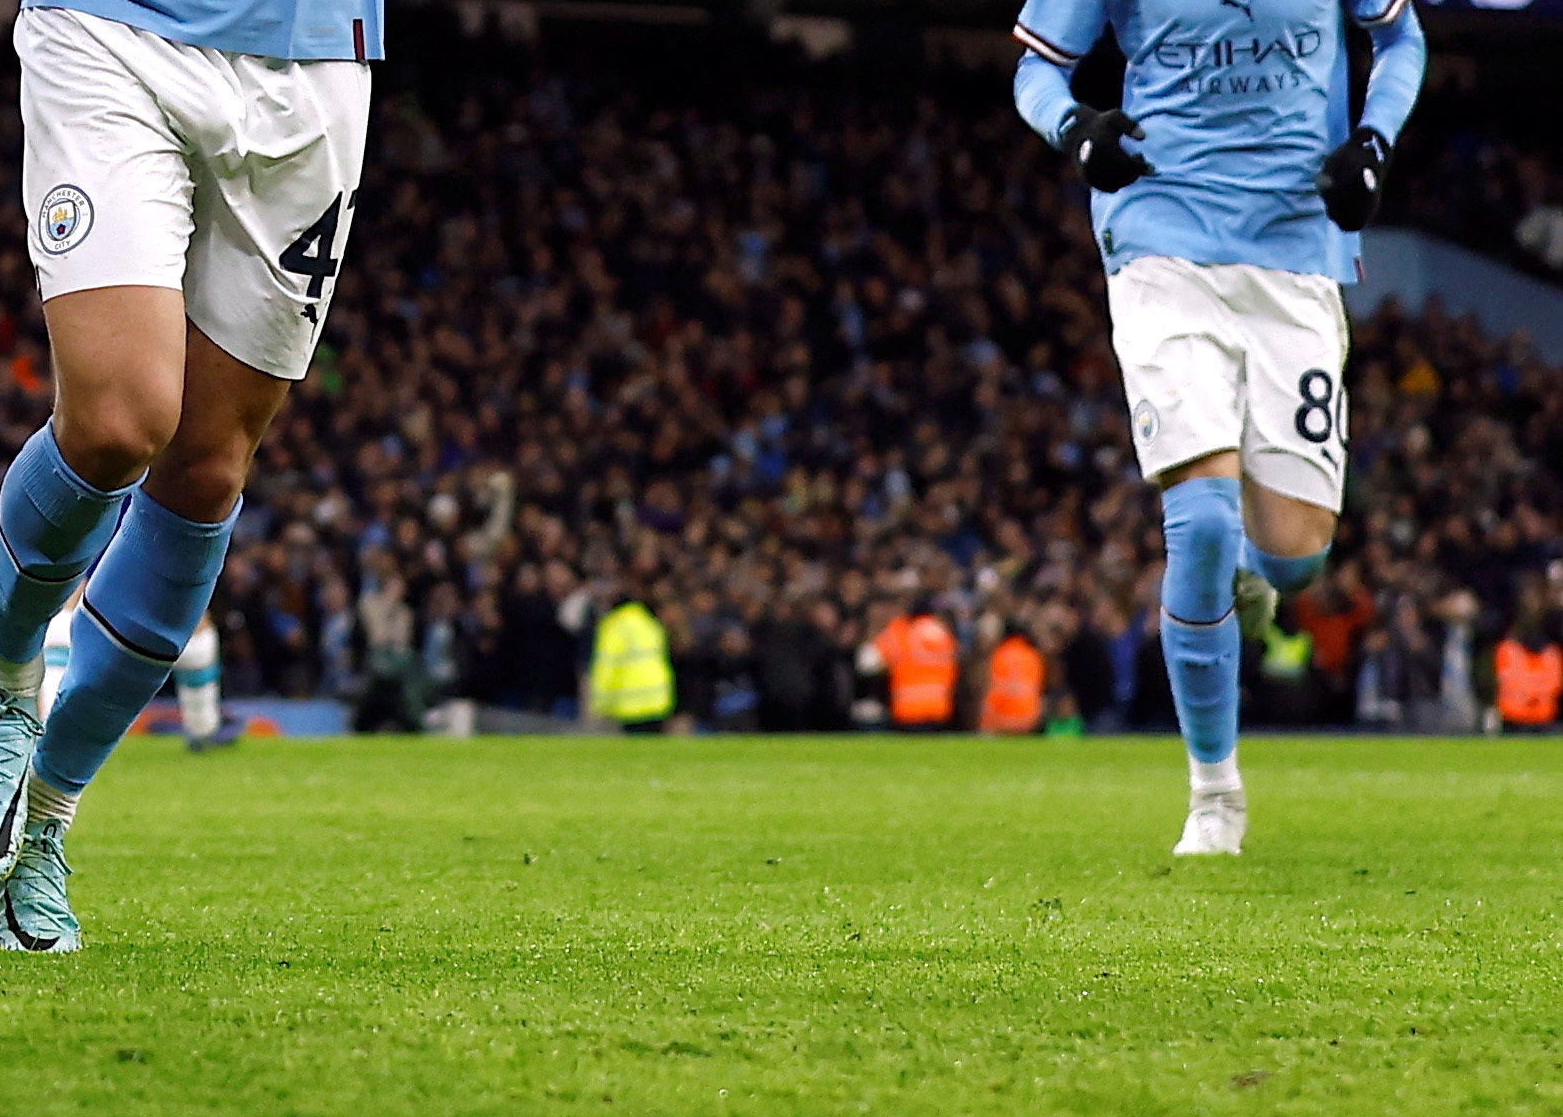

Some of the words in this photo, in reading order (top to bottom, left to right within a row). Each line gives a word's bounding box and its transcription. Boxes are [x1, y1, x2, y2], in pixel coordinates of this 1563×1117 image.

[1154, 29, 1322, 69] ETIHAD
[1181, 70, 1301, 94] AIRWAYS
[41, 189, 85, 219] MANCHESTER
[54, 240, 71, 250] CITY
